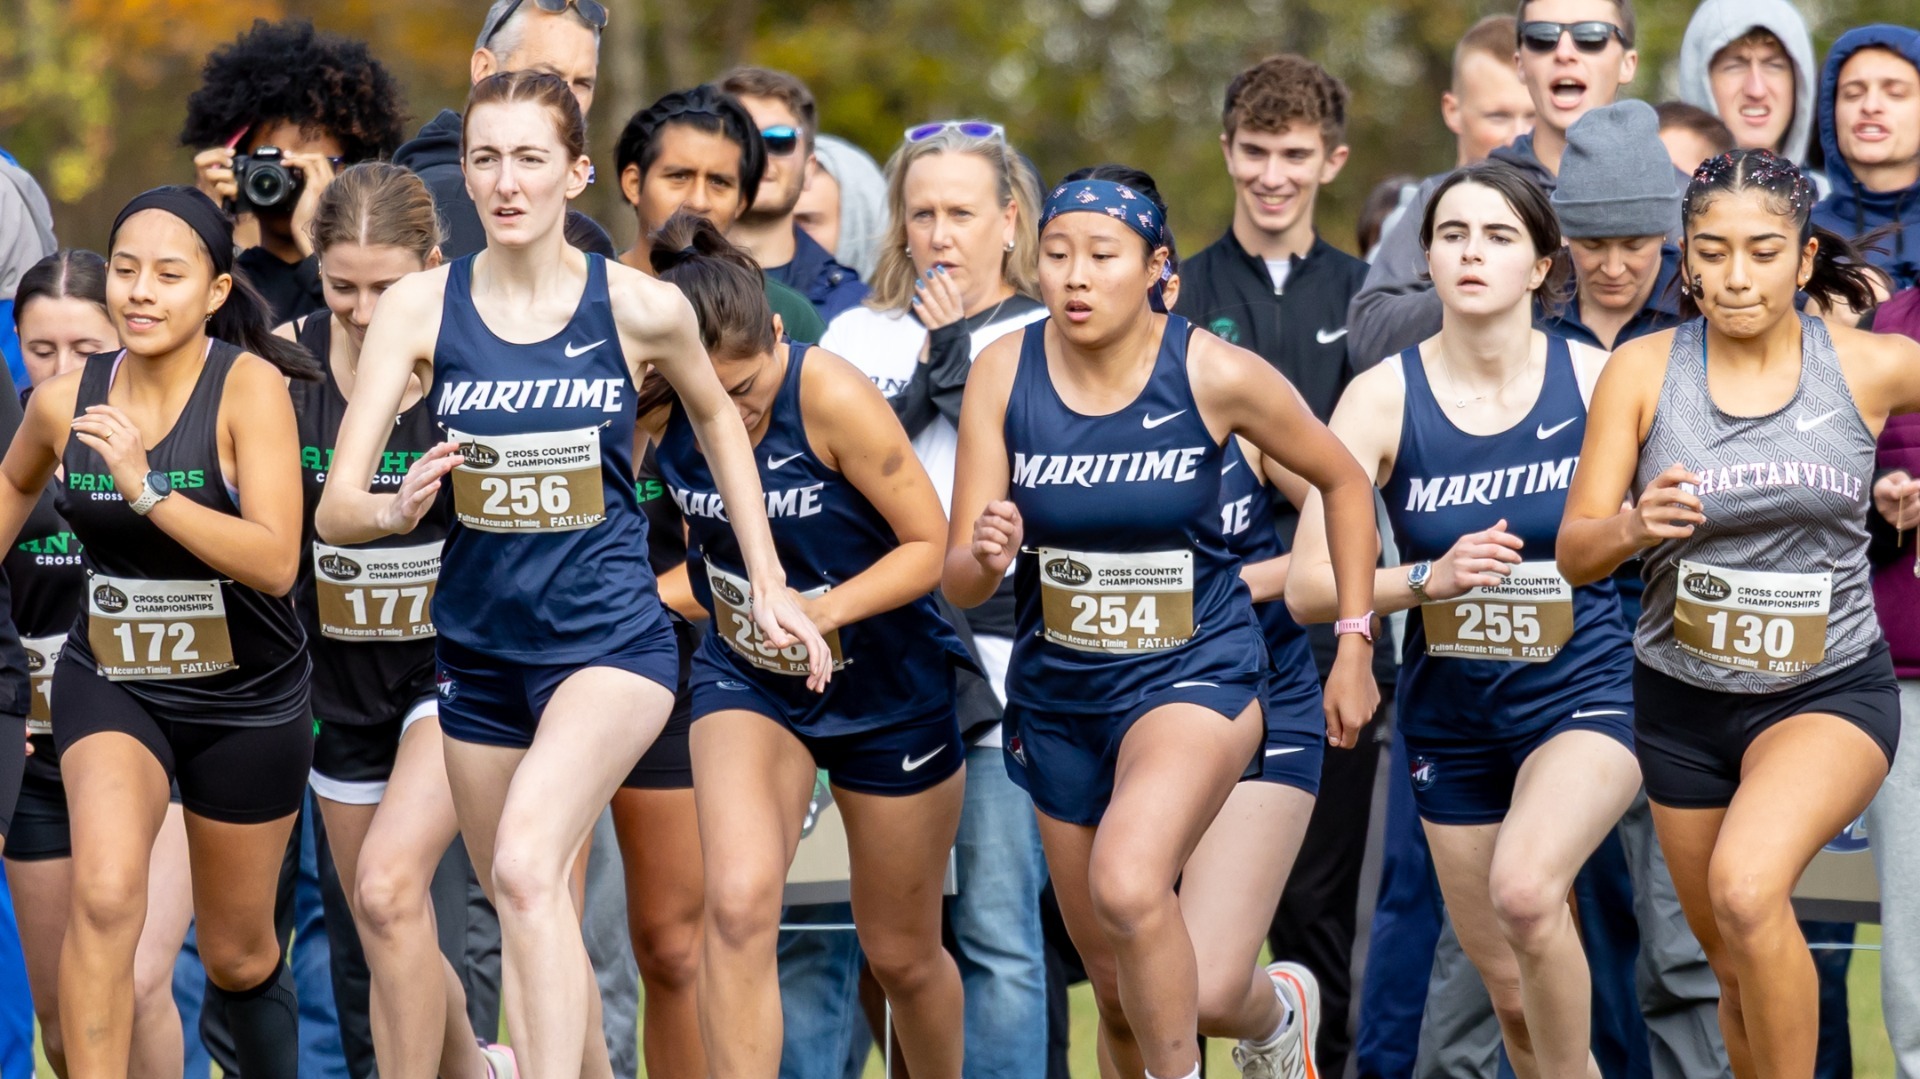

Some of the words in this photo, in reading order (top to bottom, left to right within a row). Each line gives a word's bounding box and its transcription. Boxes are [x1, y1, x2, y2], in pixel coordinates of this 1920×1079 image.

[437, 378, 625, 416] MARITIME
[505, 449, 539, 459] CROSS
[541, 444, 590, 456] COUNTRY
[463, 456, 493, 464] KYLINE
[507, 454, 590, 467] CHAMPIONSHIPS
[1012, 447, 1206, 488] MARITIME
[69, 470, 205, 491] PANRS
[1405, 456, 1580, 512] MARITIM
[1680, 462, 1862, 502] HATTANVILLE
[91, 492, 123, 500] CROSS
[481, 475, 570, 515] 256
[667, 482, 824, 522] MARME
[480, 518, 513, 528] Accurate
[515, 519, 540, 528] Timing
[36, 555, 82, 565] CROSS
[367, 562, 400, 571] CROSS
[1098, 569, 1132, 577] CROSS
[1135, 567, 1183, 576] COUNTRY
[1099, 577, 1183, 586] CHAMPIONSHIPS
[1514, 578, 1561, 586] COUNTRY
[1481, 586, 1561, 595] CHAMPIONSHIPS
[1690, 585, 1724, 598] SKYLINE
[1738, 587, 1771, 597] CROSS
[1774, 590, 1822, 598] COUNTRY
[133, 595, 165, 604] CROSS
[167, 594, 213, 603] COUNTRY
[345, 586, 428, 625] 177
[1738, 597, 1820, 608] CHAMPIONSHIPS
[135, 603, 214, 613] CHAMPIONSHIPS
[1071, 595, 1159, 635] 254
[1455, 603, 1540, 645] 255
[1068, 635, 1100, 647] Accurate
[1101, 638, 1127, 648] Timing
[1707, 611, 1794, 659] 130
[113, 622, 199, 662] 172
[1455, 643, 1487, 653] Accurate
[1699, 649, 1732, 663] Accurate
[1733, 655, 1759, 669] Timing
